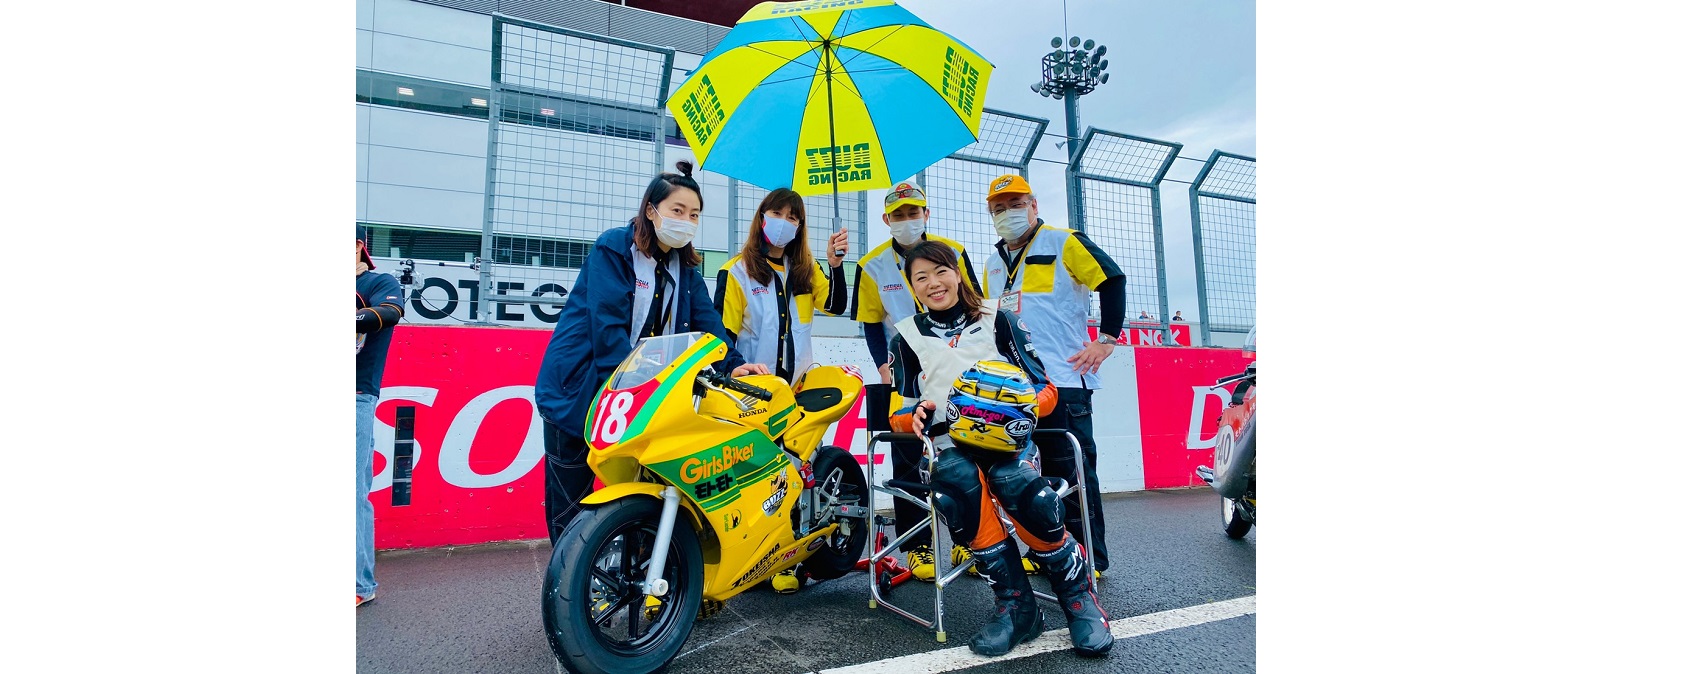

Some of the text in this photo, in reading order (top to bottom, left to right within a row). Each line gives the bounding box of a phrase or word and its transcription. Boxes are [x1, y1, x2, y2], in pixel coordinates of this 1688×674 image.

[402, 277, 569, 324] OTEG
[591, 391, 634, 443] 18
[738, 408, 768, 419] HONDA
